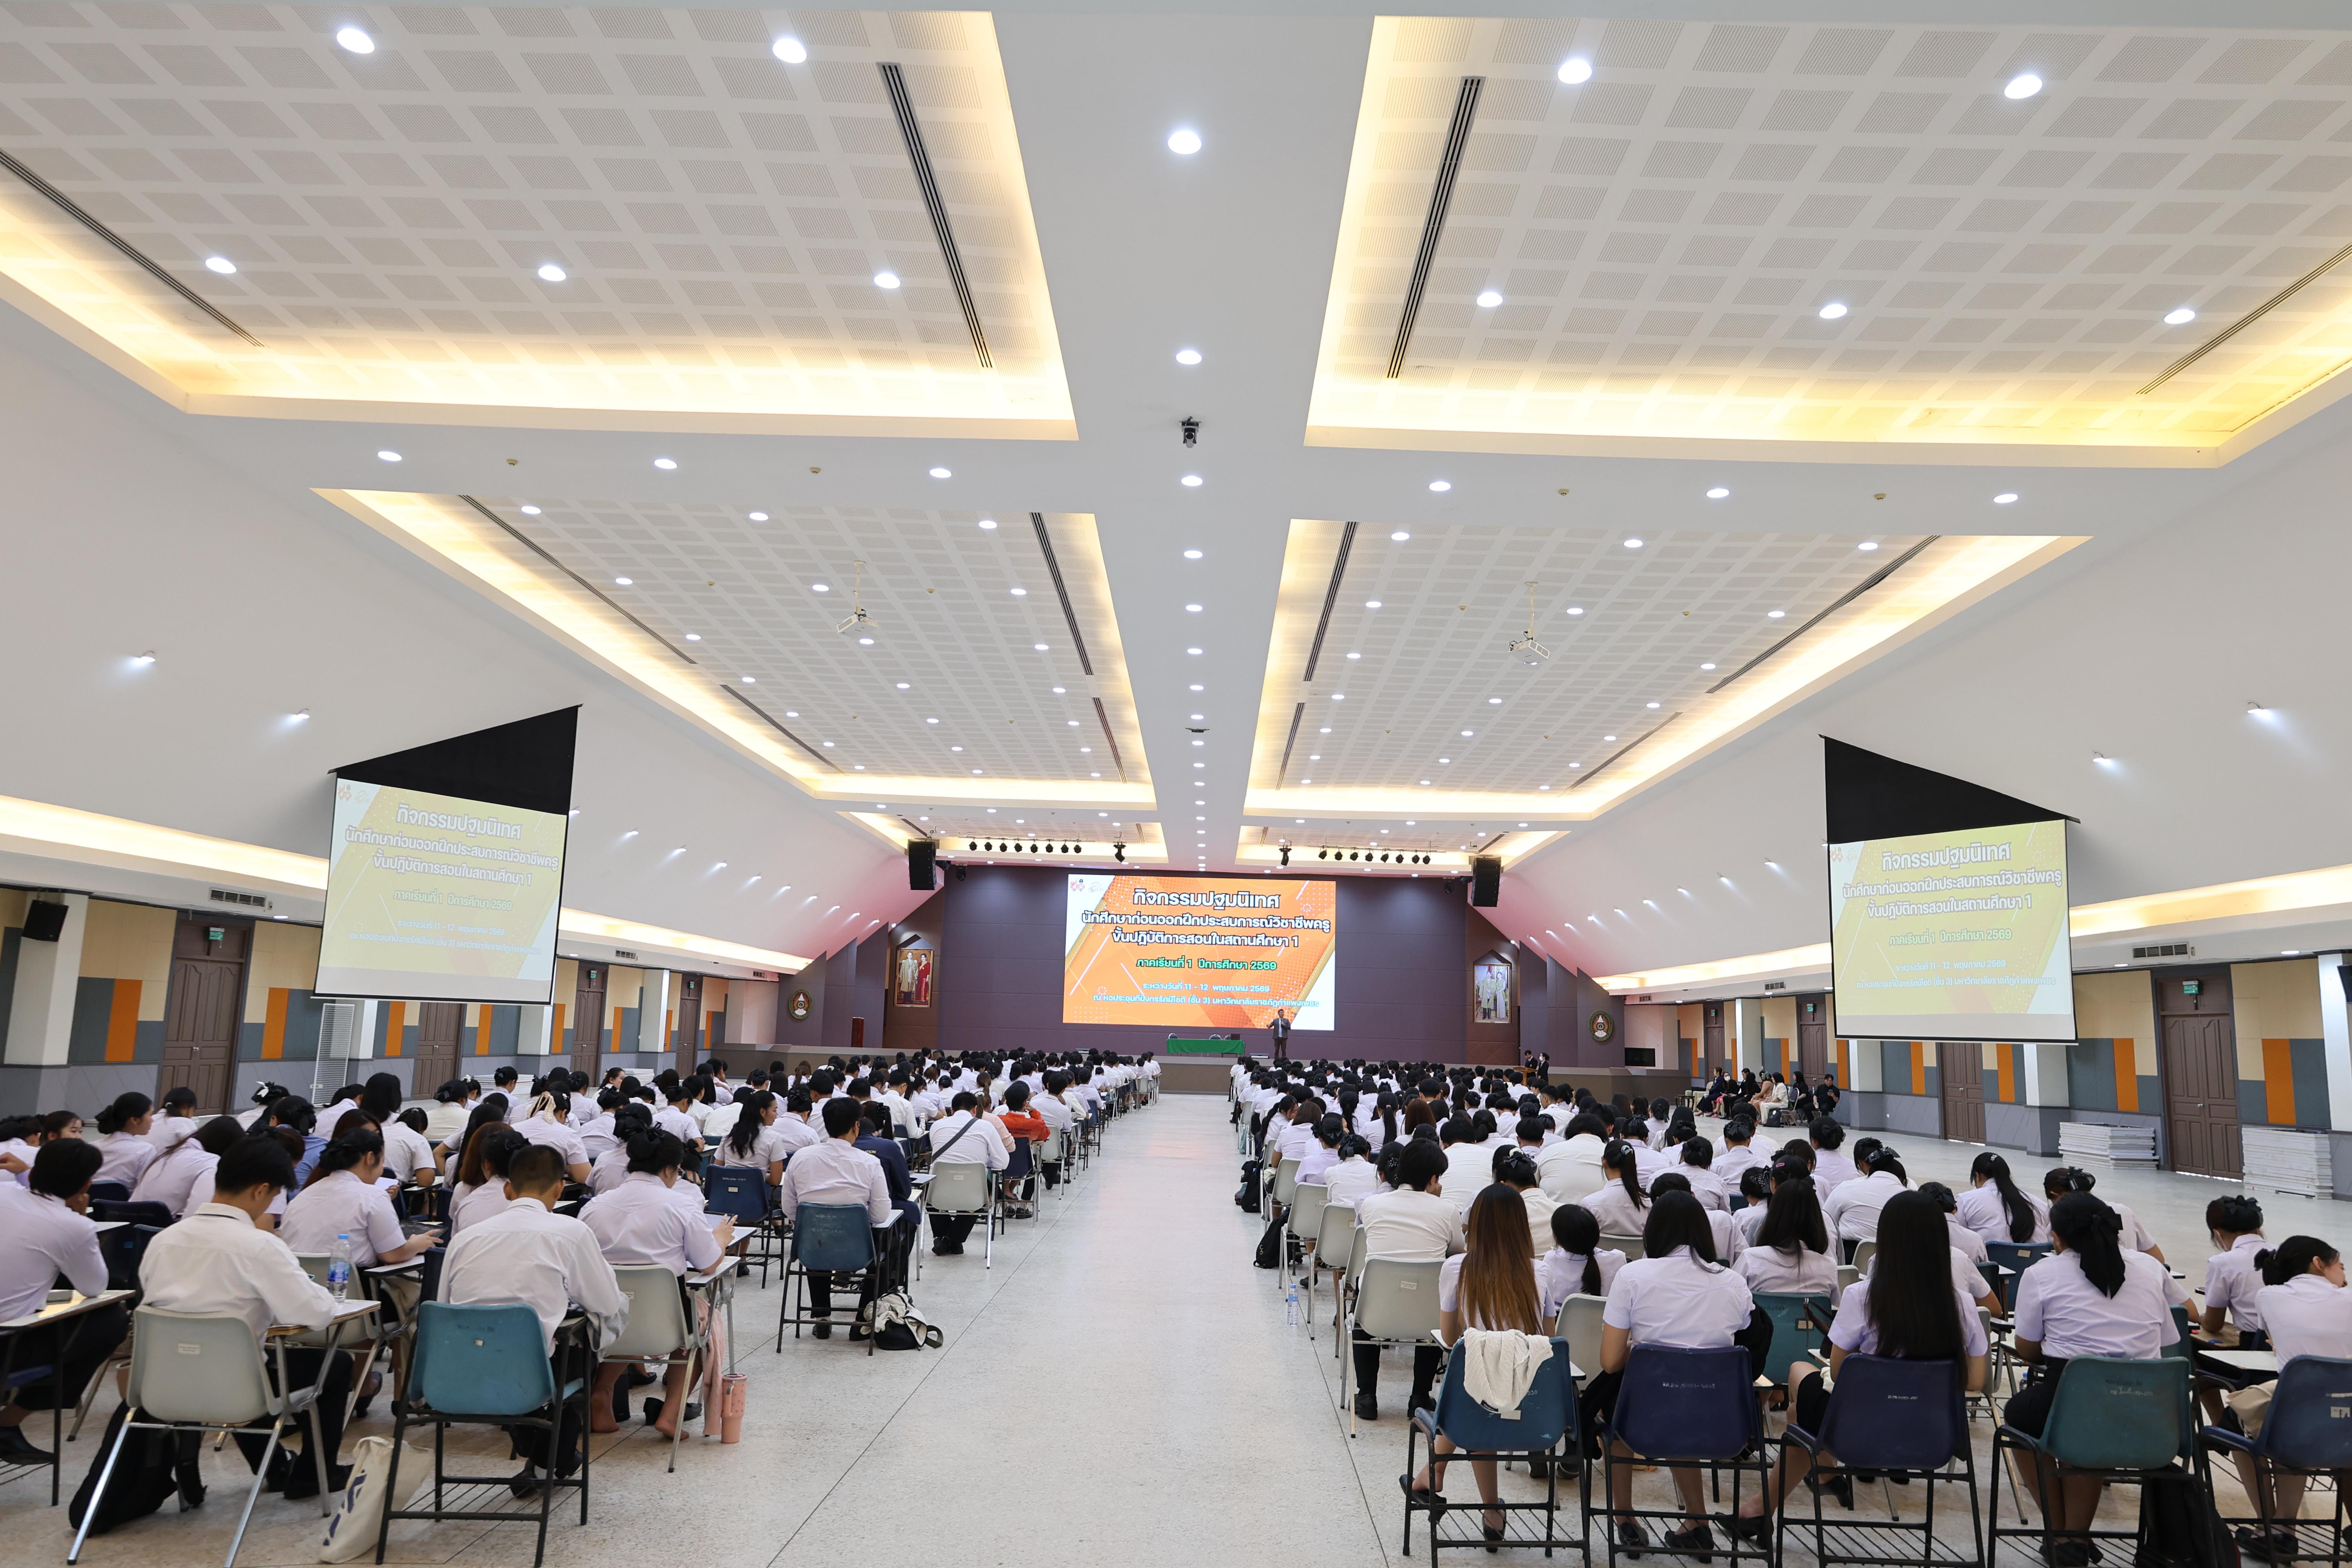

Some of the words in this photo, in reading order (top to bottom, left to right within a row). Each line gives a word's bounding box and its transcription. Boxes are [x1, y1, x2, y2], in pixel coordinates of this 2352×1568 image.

[397, 804, 522, 840] กิจกรรมปฐมนิเทศ
[345, 825, 559, 871] นักศึกษาก่อนออกฝึกประสบการณ์วิชาชีพครู
[1882, 842, 2011, 871] กิจกรรมปฐมนิเทศ
[373, 848, 524, 885] ขั้นปฏิบัติการสอนในสถานศึกษา
[527, 873, 532, 886] 1
[1843, 867, 2062, 898] นักศึกษาก่อนออกฝึกประสบการณ์วิชาชีพครู
[394, 888, 437, 904] ภาคเรียนที่
[439, 893, 443, 904] 1
[448, 892, 490, 909] ปีการศึกษา
[491, 900, 512, 911] 2569
[1134, 889, 1280, 910] กิจกรรมปฐมนิเทศ
[1867, 893, 2023, 920] ขั้นปฏิบัติการสอนในสถานศึกษา
[2025, 893, 2032, 909] 1
[397, 919, 433, 929] ระหว่างวันที่
[458, 925, 488, 935] พฤษภาคม
[489, 927, 505, 936] 2569
[1082, 911, 1330, 933] นักศึกษาก่อนออกฝึกประสบการณ์วิชาชีพครู
[436, 936, 446, 947] (ชั้น
[448, 939, 455, 947] 3)
[1112, 927, 1289, 947] ขั้นปฏิบัติการสอนในสถานศึกษา
[1292, 936, 1298, 947] 1
[1889, 928, 1929, 946] ภาคเรียนที่
[1931, 932, 1935, 943] 1
[1940, 929, 1985, 943] ปีการศึกษา
[1986, 928, 2013, 940] 2569
[1136, 956, 1185, 967] ภาคเรียนที่
[1187, 959, 1192, 968] 1
[1198, 958, 1248, 969] ปีการศึกษา
[1250, 962, 1277, 970] 2569
[1896, 960, 1929, 972] ระหว่างวันที่
[1942, 961, 1951, 969] 12
[1954, 961, 1985, 970] พฤษภาคม
[1143, 981, 1183, 990] ระหว่างวันที่
[1933, 975, 1944, 986] (ชั้น
[1946, 977, 1953, 985] 3)
[1188, 995, 1201, 1004] (ชั้น
